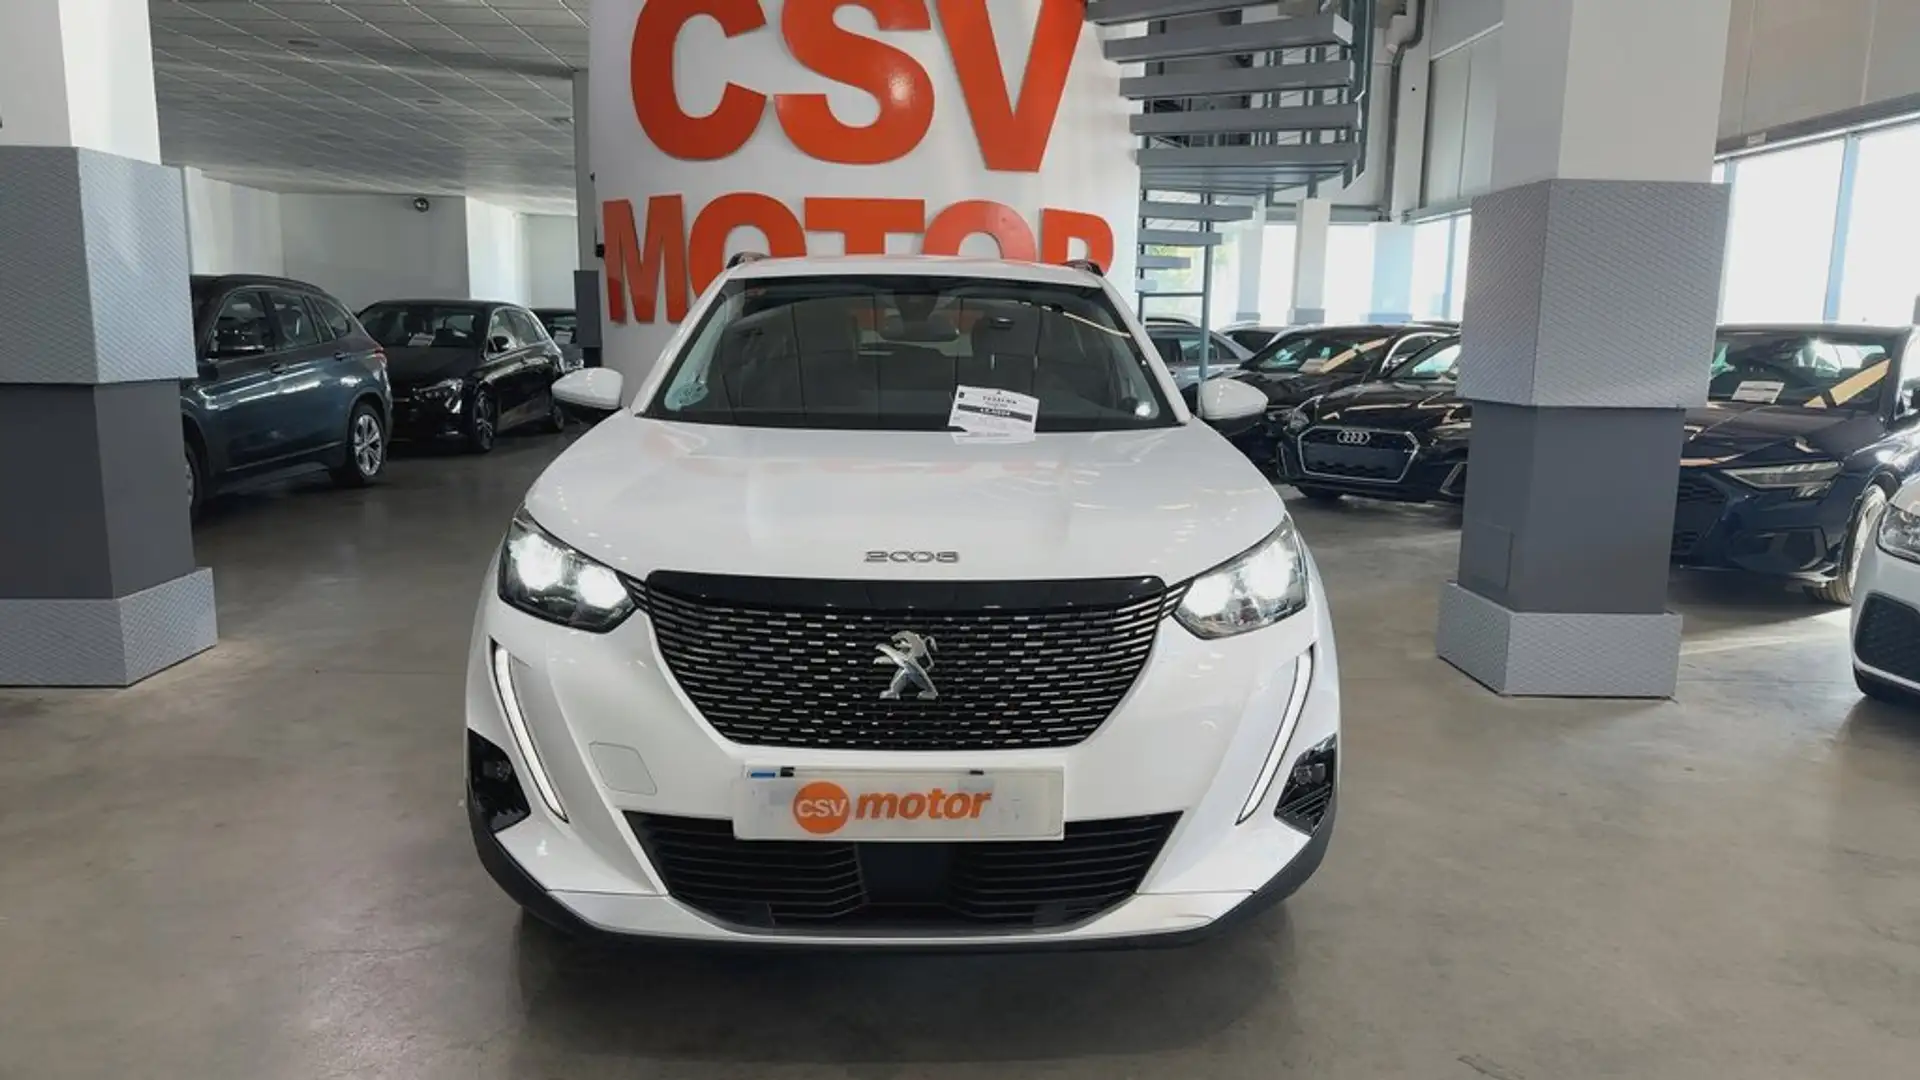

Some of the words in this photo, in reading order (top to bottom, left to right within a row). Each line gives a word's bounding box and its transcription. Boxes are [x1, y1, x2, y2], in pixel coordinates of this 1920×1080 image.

[630, 0, 1086, 173] CSV
[864, 550, 960, 563] 2008
[797, 798, 848, 818] CSV
[855, 787, 992, 819] motor
